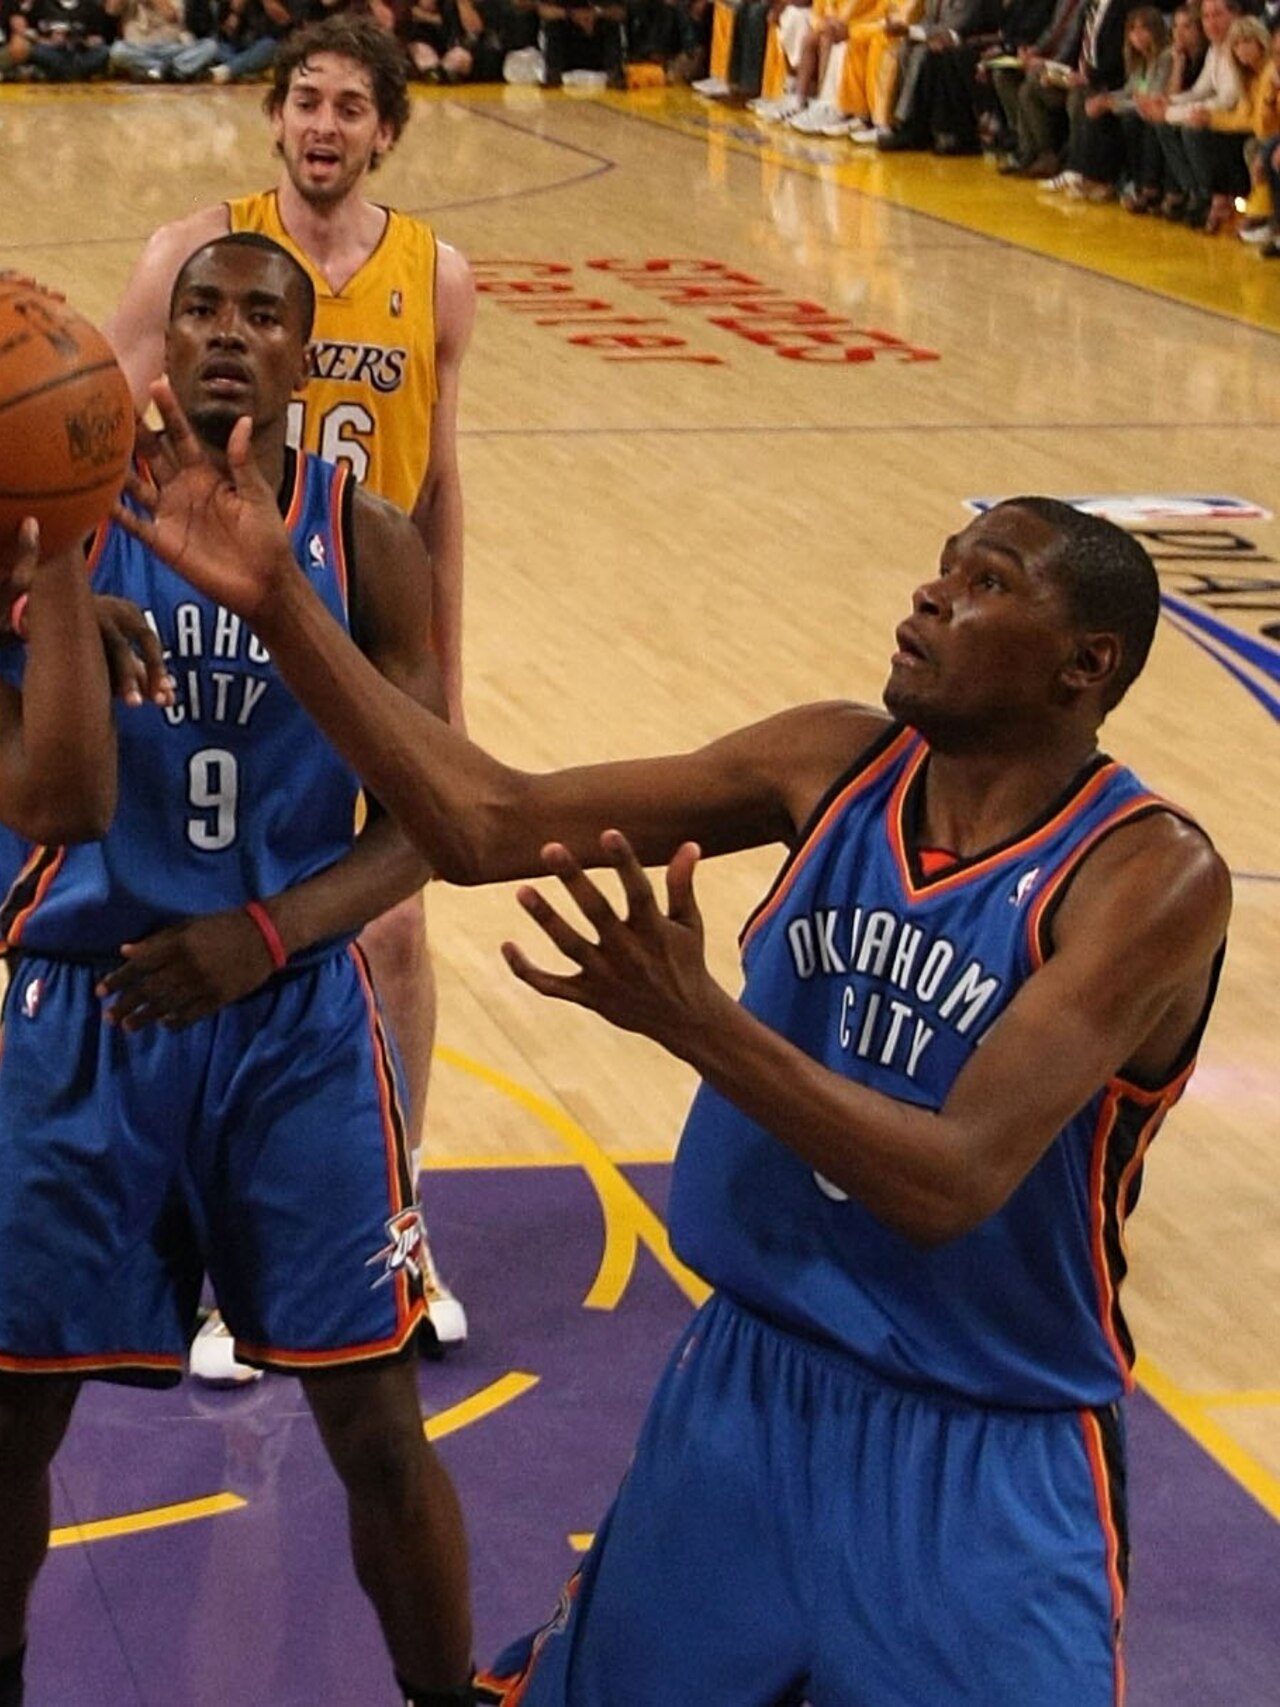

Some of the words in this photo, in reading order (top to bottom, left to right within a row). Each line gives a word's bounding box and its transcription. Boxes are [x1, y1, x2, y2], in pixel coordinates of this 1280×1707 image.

[585, 258, 941, 364] STAPLES
[306, 341, 408, 393] KERS
[163, 669, 269, 725] CITY
[186, 747, 239, 851] 9
[787, 907, 1001, 1047] OKLAHOM
[839, 985, 935, 1078] CITY
